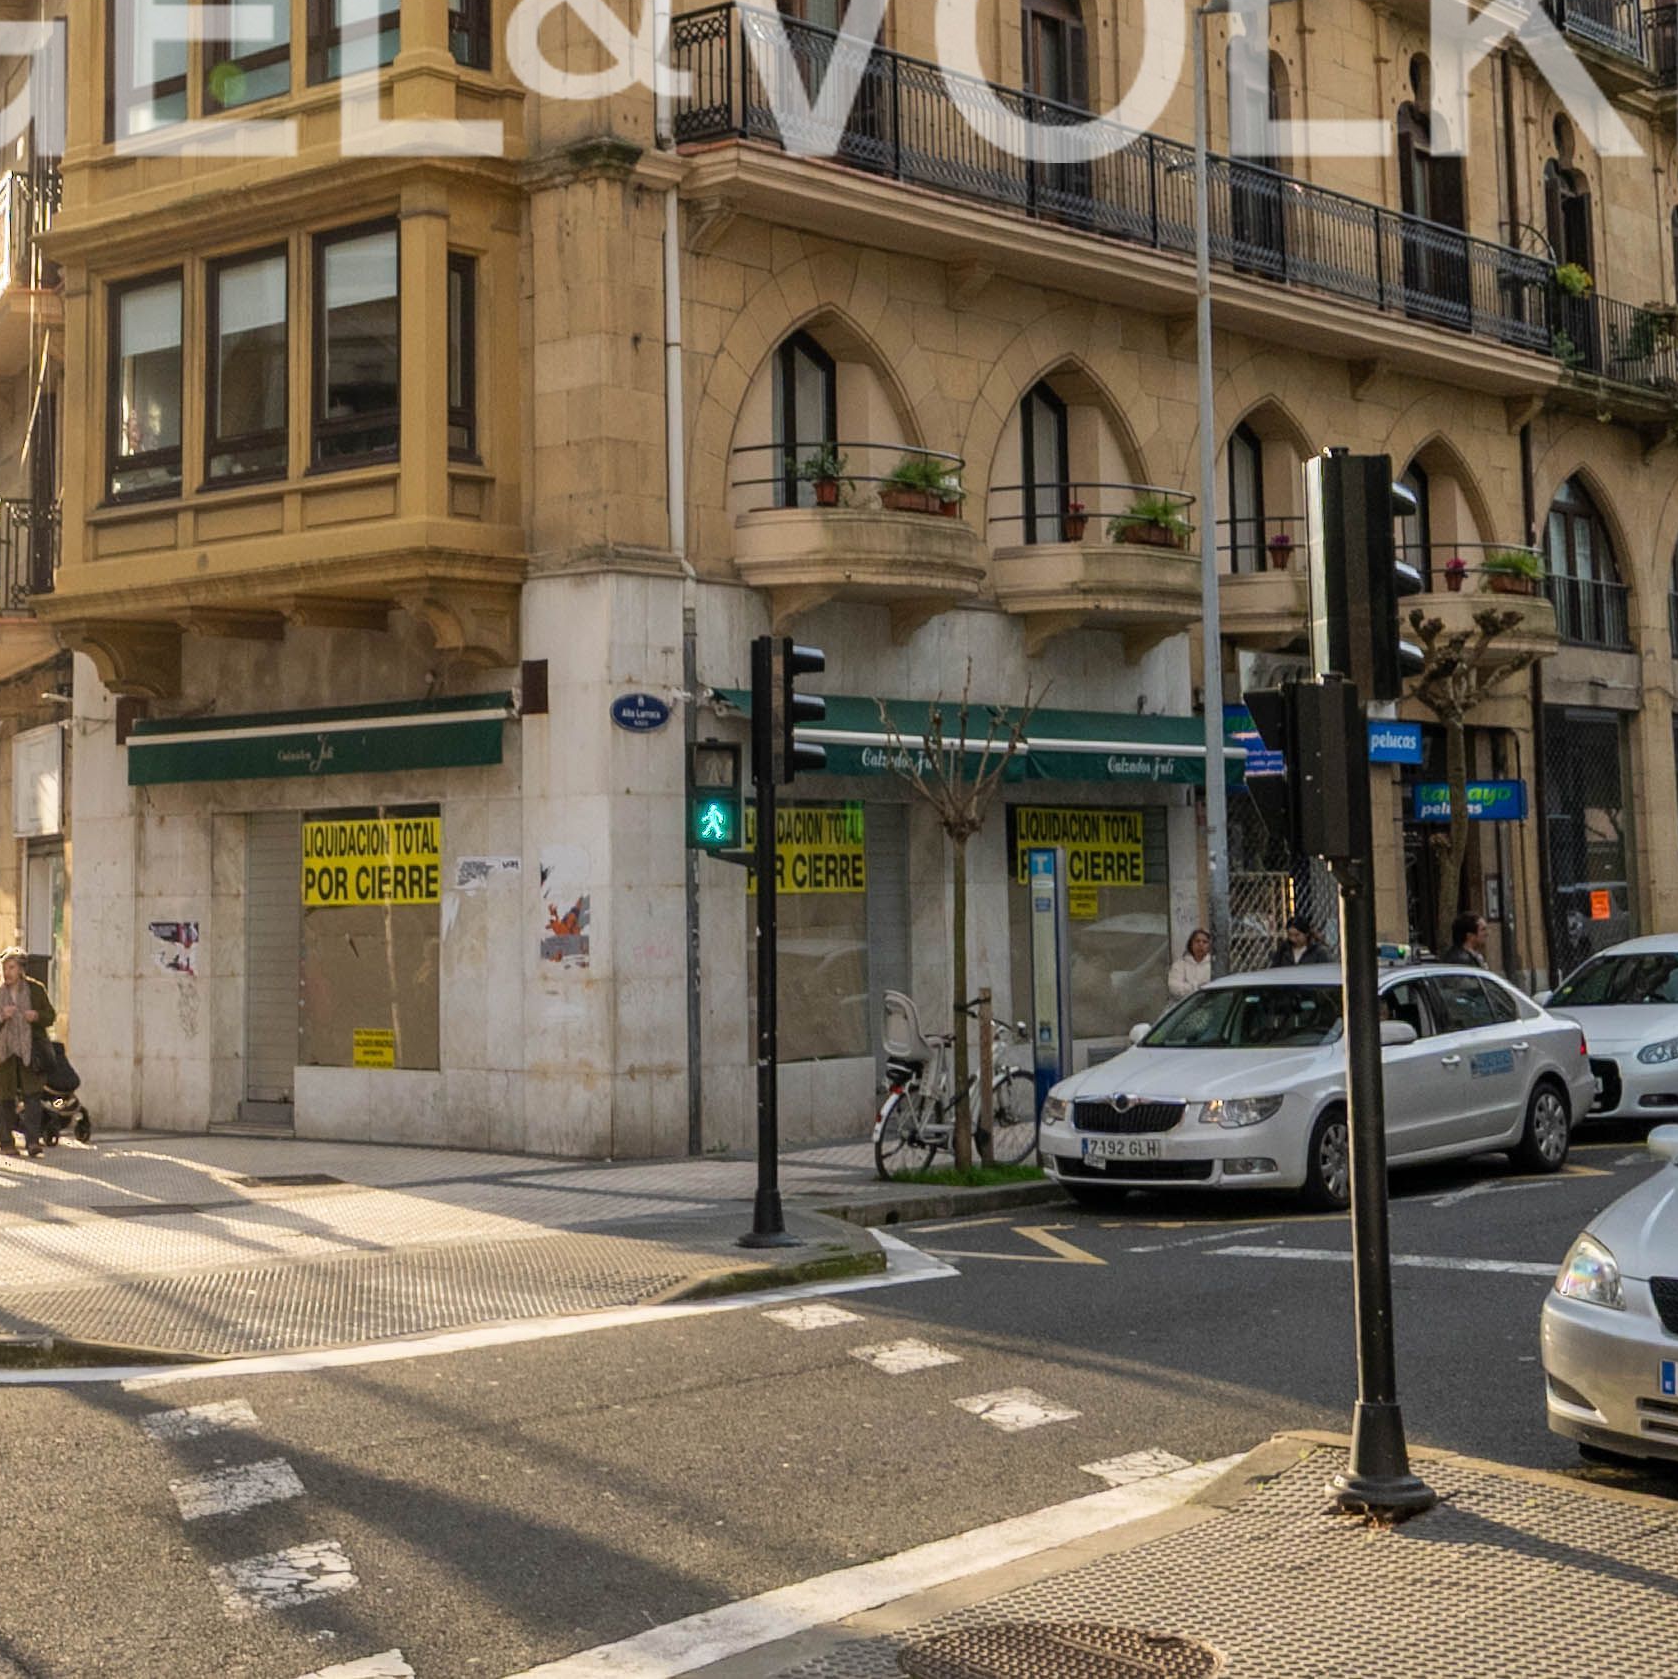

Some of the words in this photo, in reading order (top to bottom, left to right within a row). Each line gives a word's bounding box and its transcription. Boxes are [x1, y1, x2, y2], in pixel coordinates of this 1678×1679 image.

[1371, 731, 1416, 752] pelucas
[1107, 755, 1151, 774] Calzados
[1422, 786, 1512, 807] taayo
[304, 824, 390, 858] LIQUIDACION
[394, 821, 438, 854] TOTAL
[745, 811, 823, 844] LIDACION
[826, 812, 864, 844] TOTAL
[1019, 811, 1100, 843] LIQUIDACION
[1105, 815, 1141, 844] TOTAL
[792, 853, 863, 888] CIERRE
[1070, 850, 1141, 881] CIERRE
[305, 867, 348, 900] POR
[356, 864, 438, 899] CIERRE
[1090, 1140, 1125, 1155] 7192
[1129, 1141, 1156, 1156] GLH
